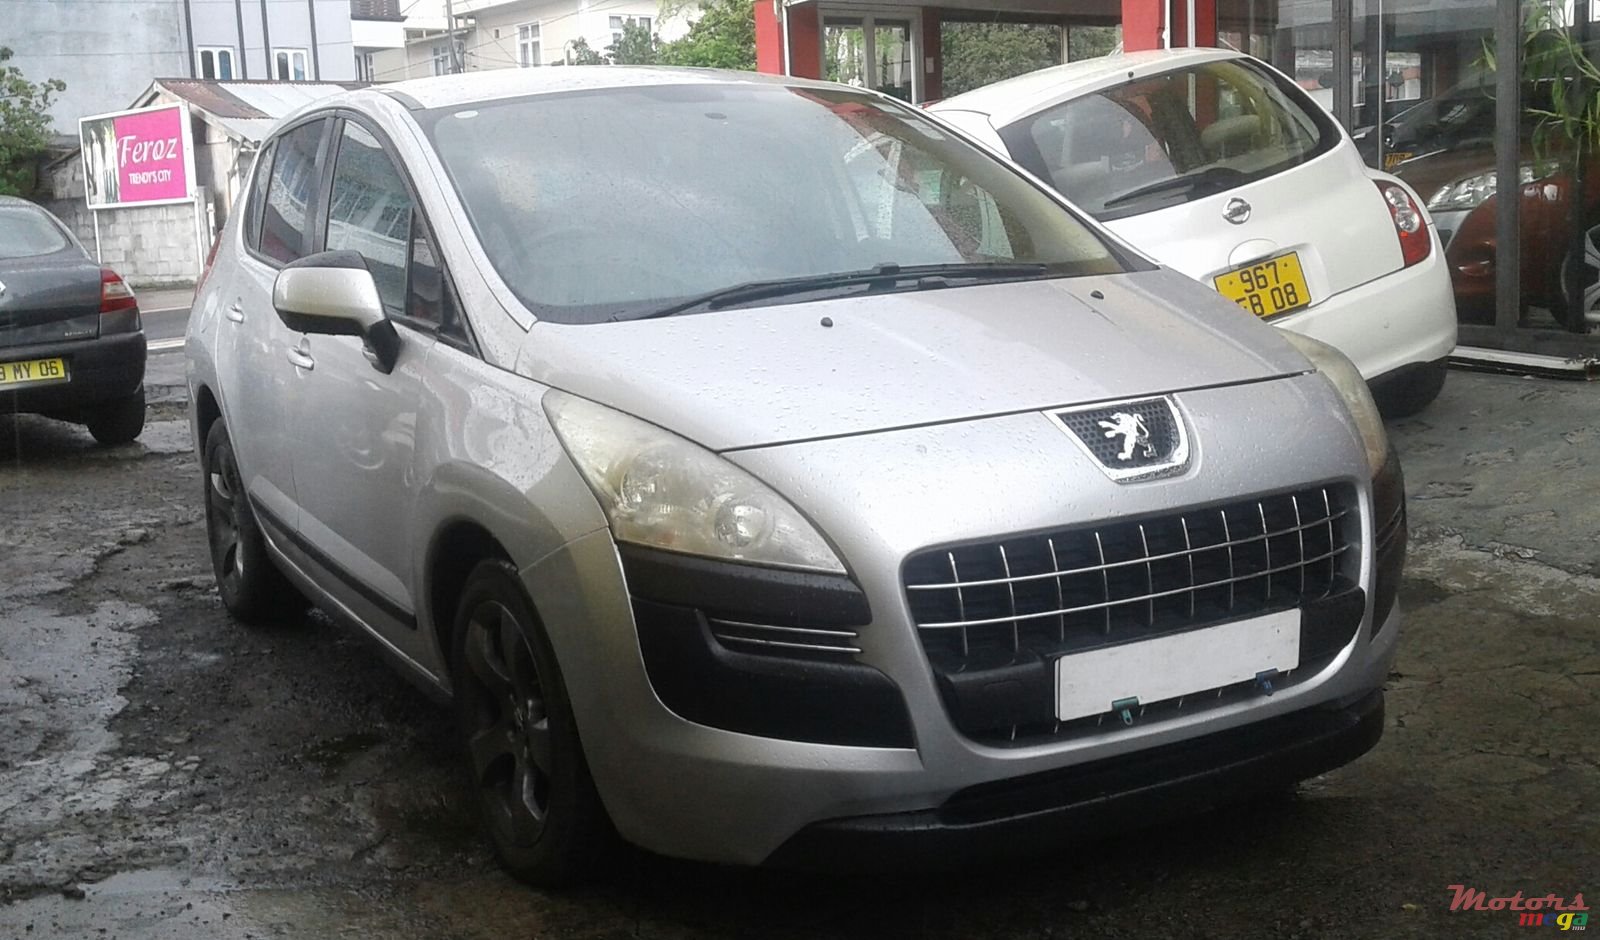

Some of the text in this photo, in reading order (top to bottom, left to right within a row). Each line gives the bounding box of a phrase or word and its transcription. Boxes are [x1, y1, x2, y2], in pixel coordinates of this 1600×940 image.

[117, 135, 177, 168] Feroz
[1239, 261, 1280, 294] 967
[1235, 282, 1299, 317] B 08
[12, 362, 31, 380] MY
[39, 360, 59, 377] 06
